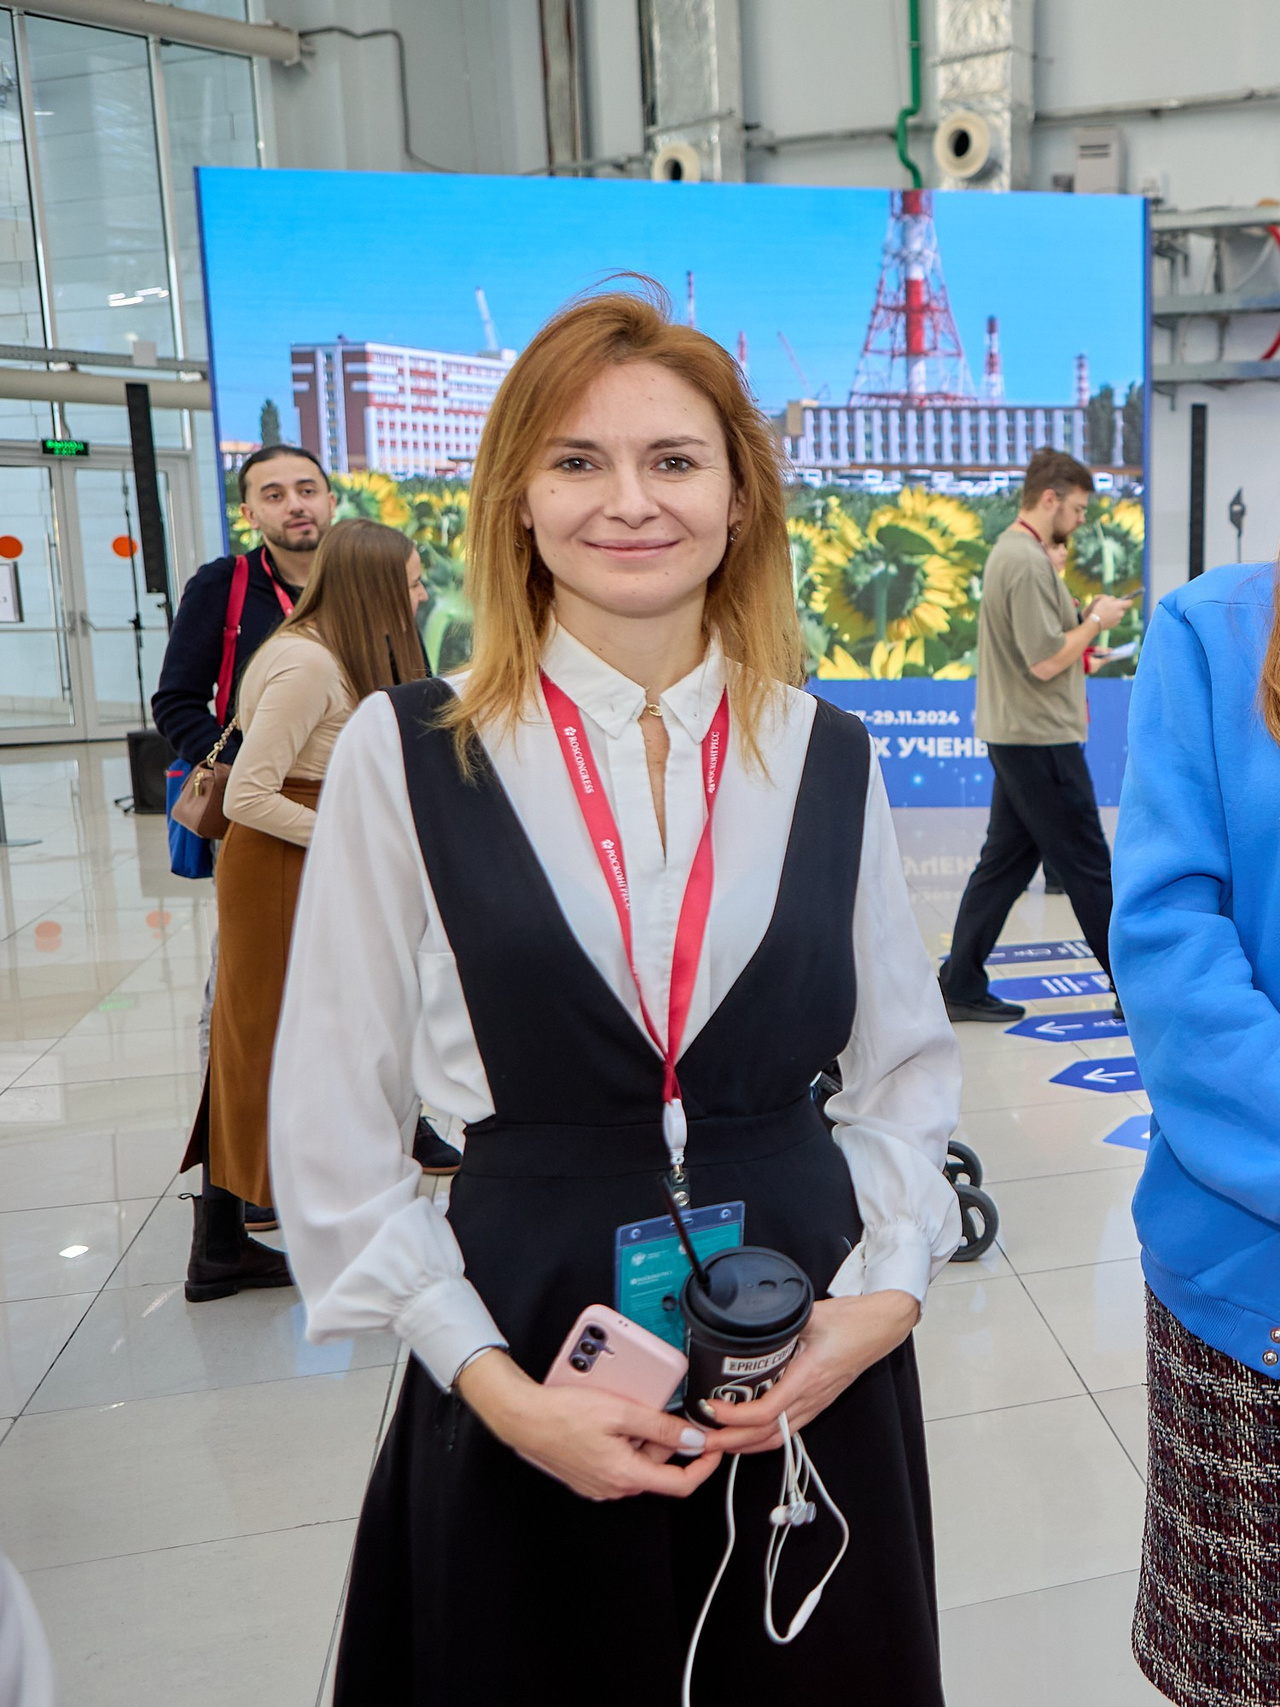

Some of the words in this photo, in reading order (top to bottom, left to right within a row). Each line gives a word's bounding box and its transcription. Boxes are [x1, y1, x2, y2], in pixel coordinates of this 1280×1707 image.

[852, 710, 960, 725] 7-29.11.2024
[568, 736, 595, 794] ROSCONGRESS
[737, 1358, 771, 1371] PRICE
